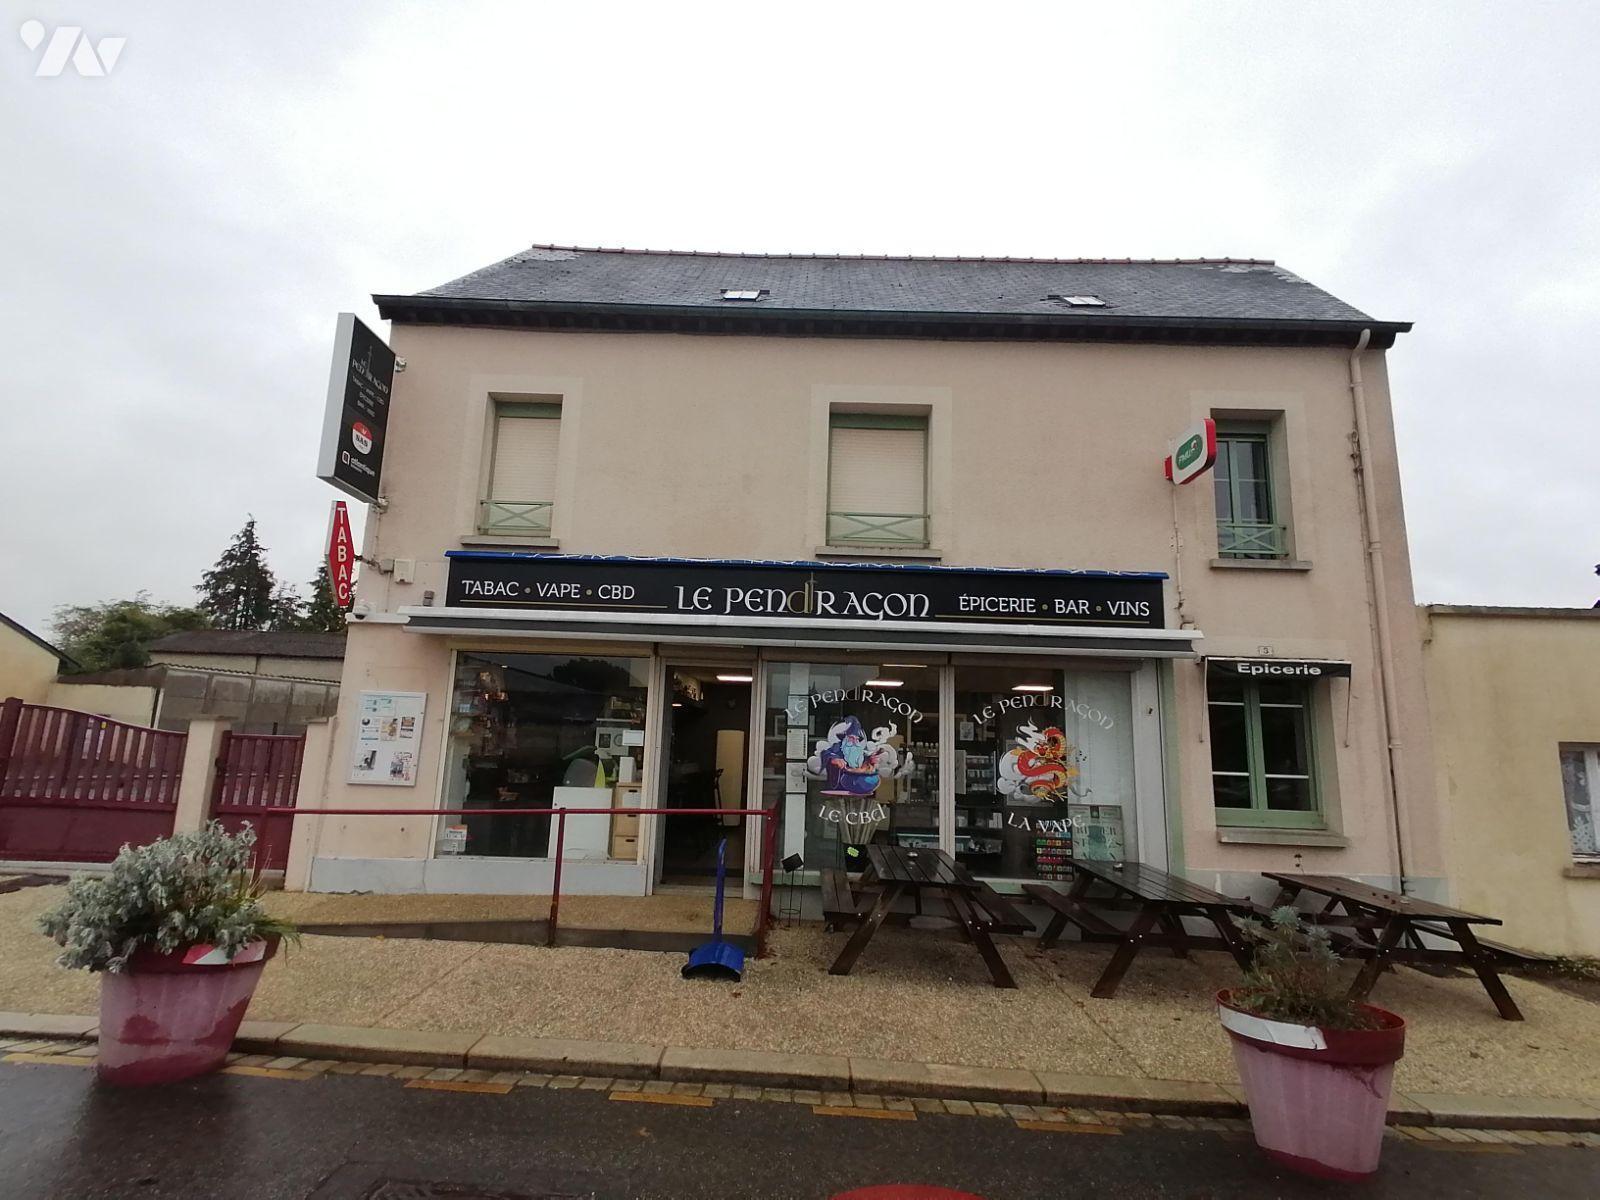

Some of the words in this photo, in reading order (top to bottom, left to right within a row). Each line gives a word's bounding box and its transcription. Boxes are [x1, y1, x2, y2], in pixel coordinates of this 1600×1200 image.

[337, 507, 348, 600] TABAC
[462, 579, 519, 598] TABAC
[537, 582, 581, 599] VAPE
[598, 584, 635, 601] CBD
[674, 585, 713, 611] LE
[959, 593, 1036, 614] ÉPICERIE
[1055, 599, 1090, 615] BAR
[1107, 600, 1150, 617] VINS
[1237, 662, 1322, 676] Epicerie
[784, 699, 808, 721] LE
[973, 705, 996, 726] LE
[818, 805, 841, 823] LE
[1007, 812, 1032, 832] LA
[1038, 814, 1086, 833] VAPE
